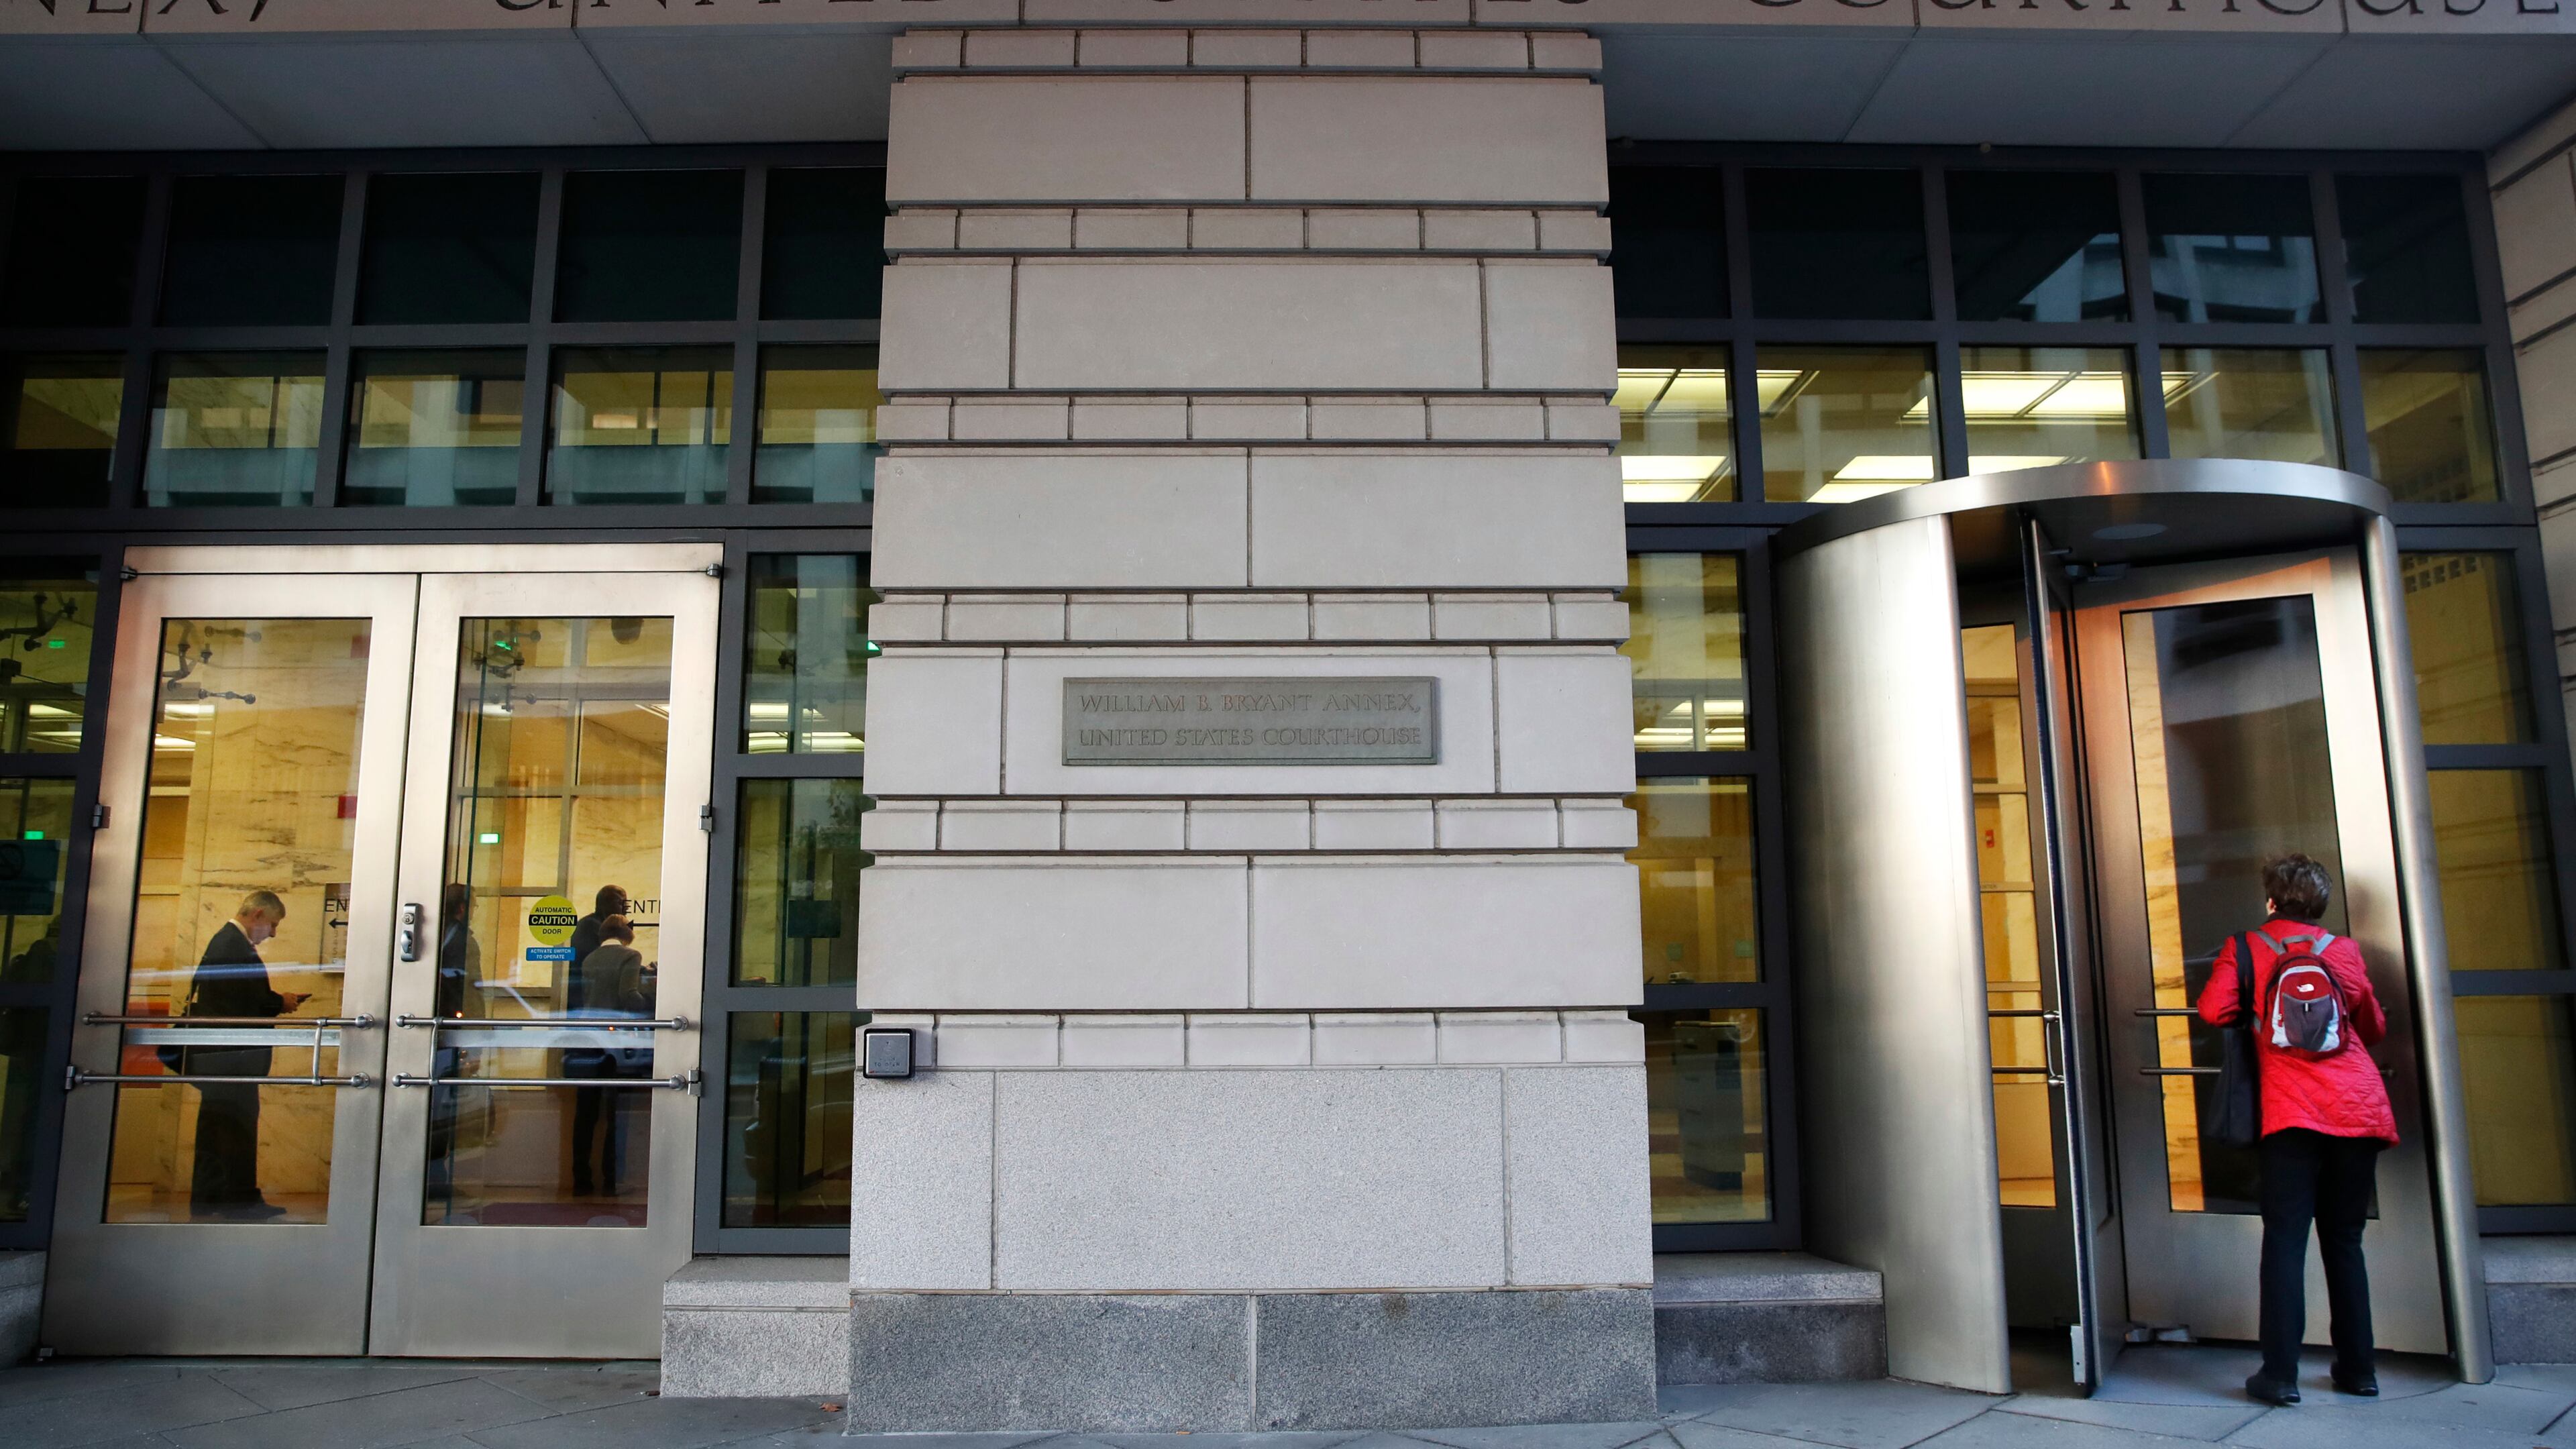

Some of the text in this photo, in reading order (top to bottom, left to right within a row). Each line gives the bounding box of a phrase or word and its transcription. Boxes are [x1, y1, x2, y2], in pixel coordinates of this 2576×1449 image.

[1079, 695, 1185, 712] WILLIAM
[1222, 694, 1312, 712] BRYANT
[1322, 694, 1421, 714] ANNEX,
[1079, 727, 1422, 747] UNITED STATES COURTHOUSE
[325, 898, 350, 912] EN
[531, 916, 576, 925] CAUTION
